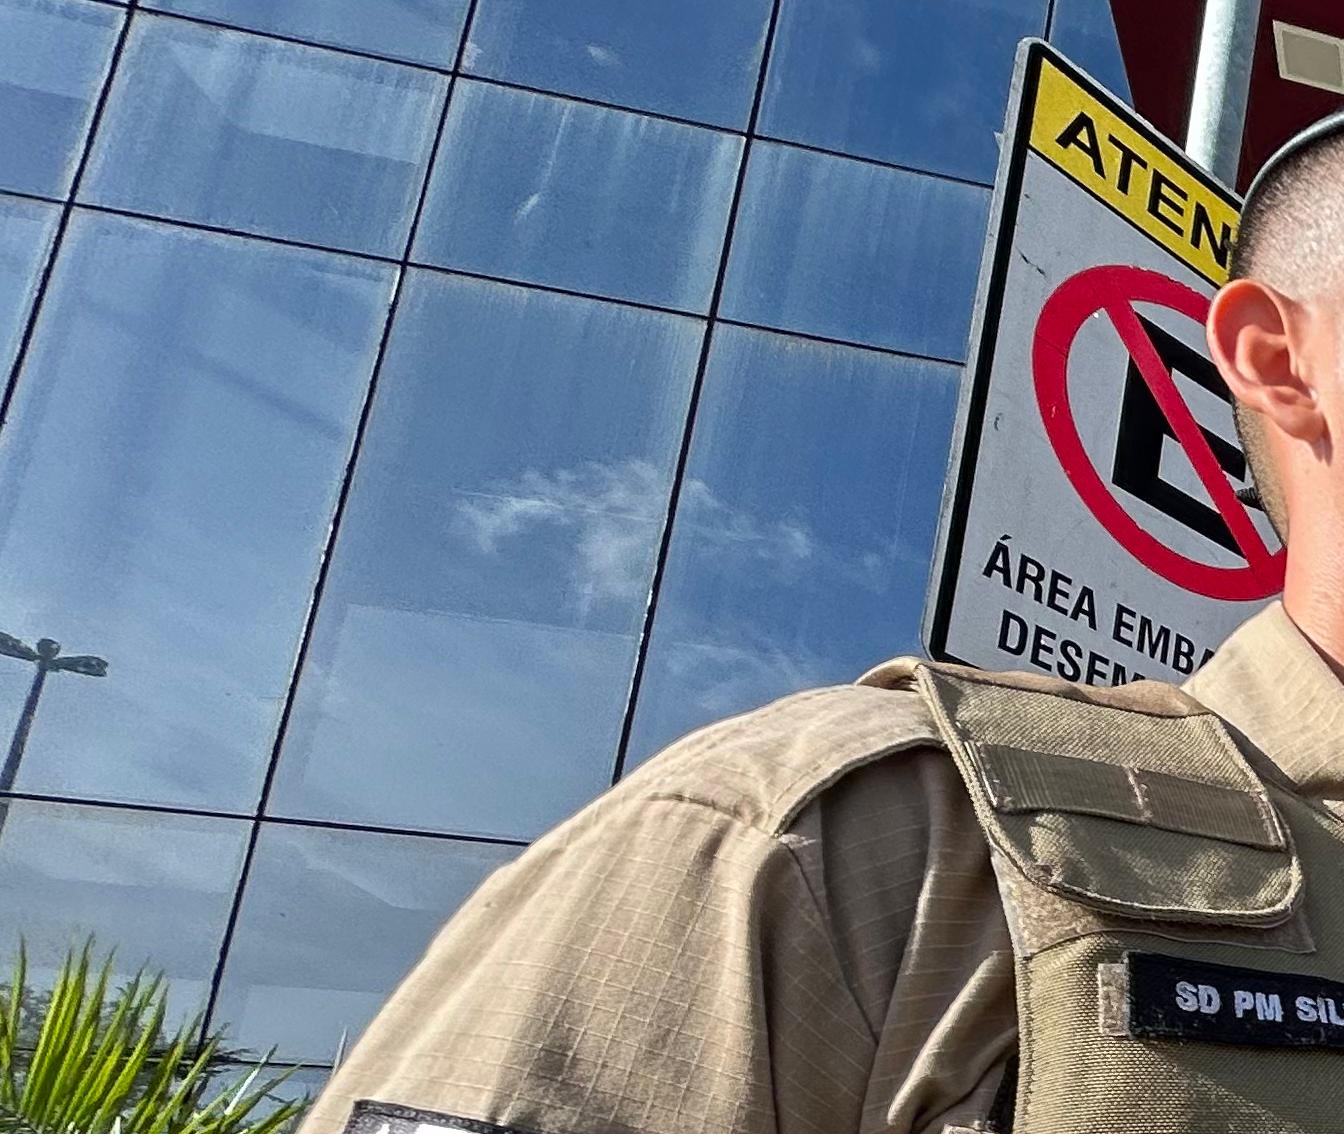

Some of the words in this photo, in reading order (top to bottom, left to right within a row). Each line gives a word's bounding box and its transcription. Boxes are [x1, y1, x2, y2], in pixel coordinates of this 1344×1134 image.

[1055, 111, 1232, 270] ATEN
[982, 534, 1097, 631] ÁREA
[1112, 602, 1216, 676] EMB
[1175, 981, 1221, 1015] SD
[1234, 990, 1283, 1022] PM
